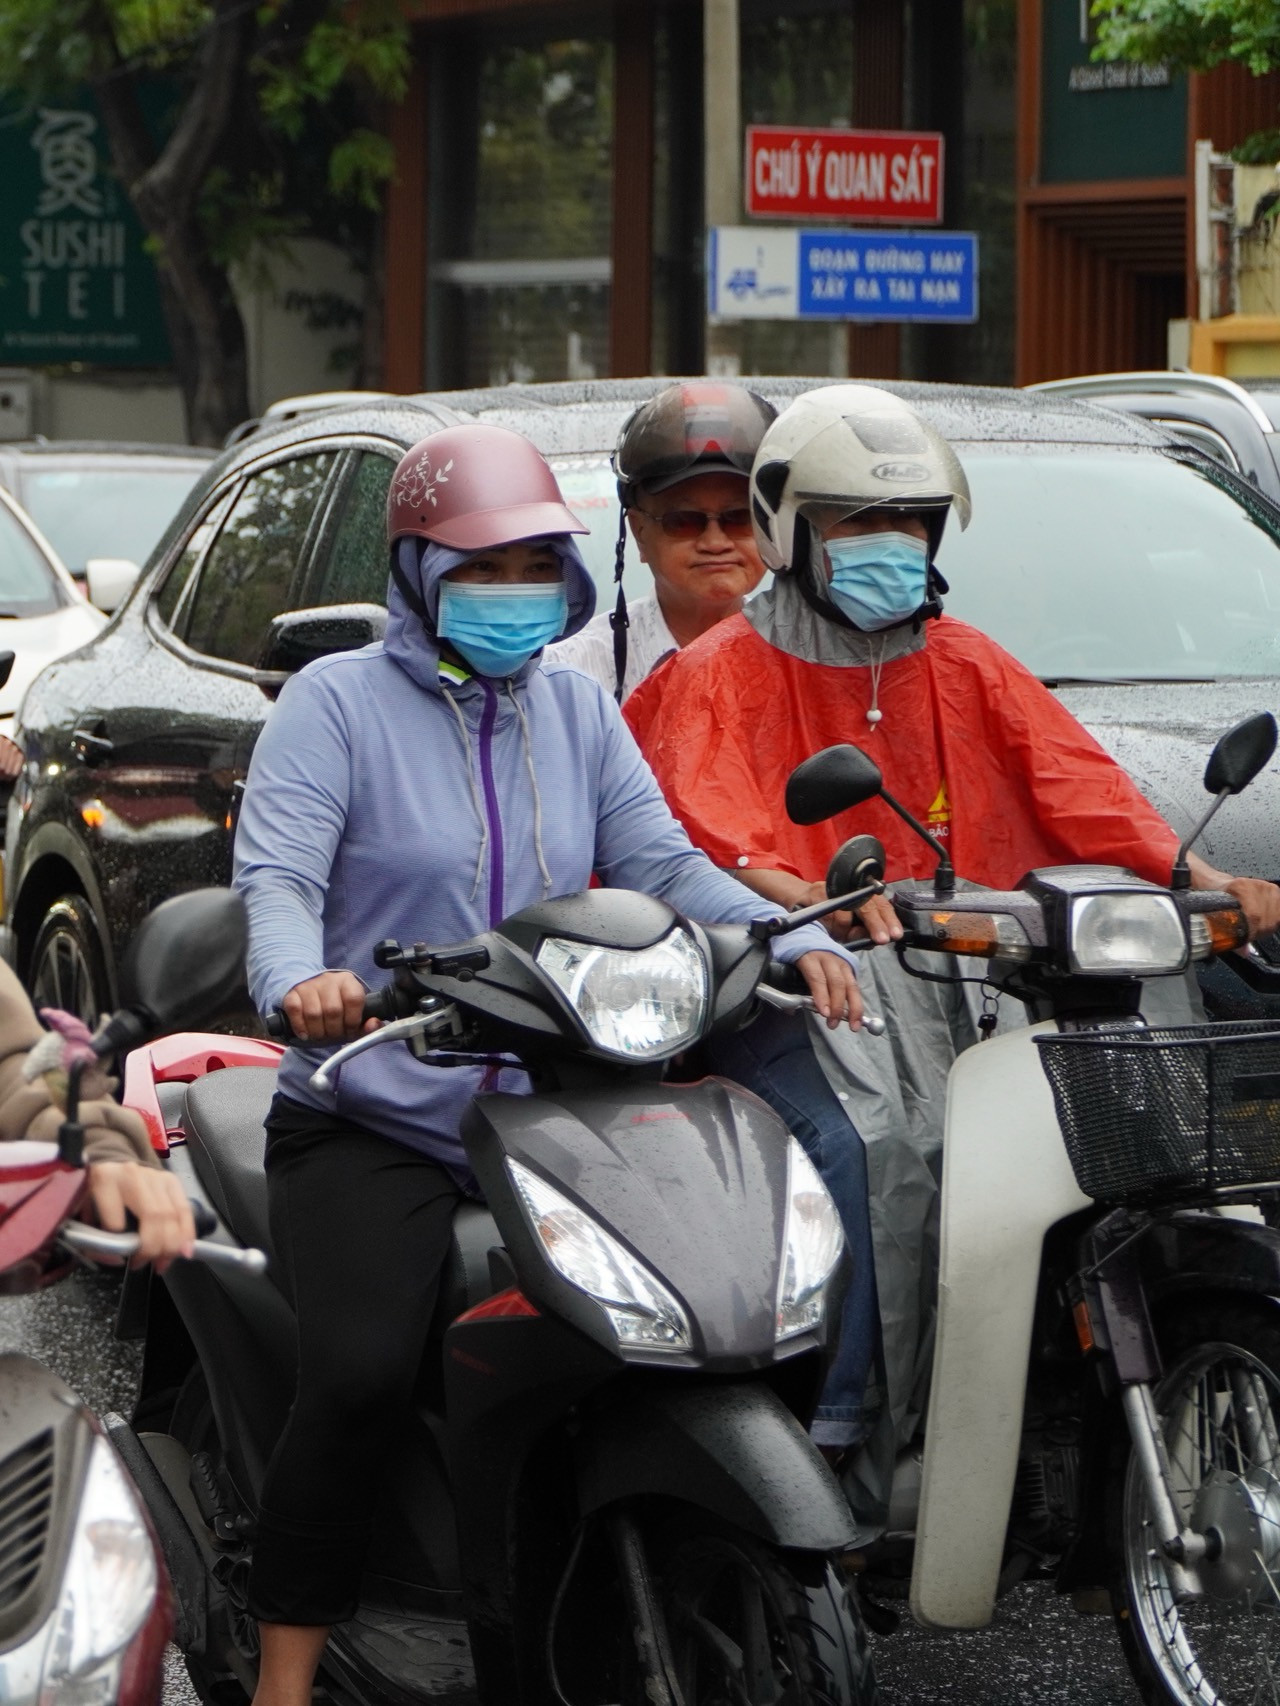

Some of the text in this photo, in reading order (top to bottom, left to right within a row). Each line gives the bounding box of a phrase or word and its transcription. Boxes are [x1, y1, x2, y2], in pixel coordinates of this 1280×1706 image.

[755, 138, 936, 203] CHÚ Ý QUAN SÁT
[21, 219, 126, 269] SUSHI
[24, 271, 126, 320] TEI
[854, 276, 882, 302] RA
[886, 277, 917, 302] TAI
